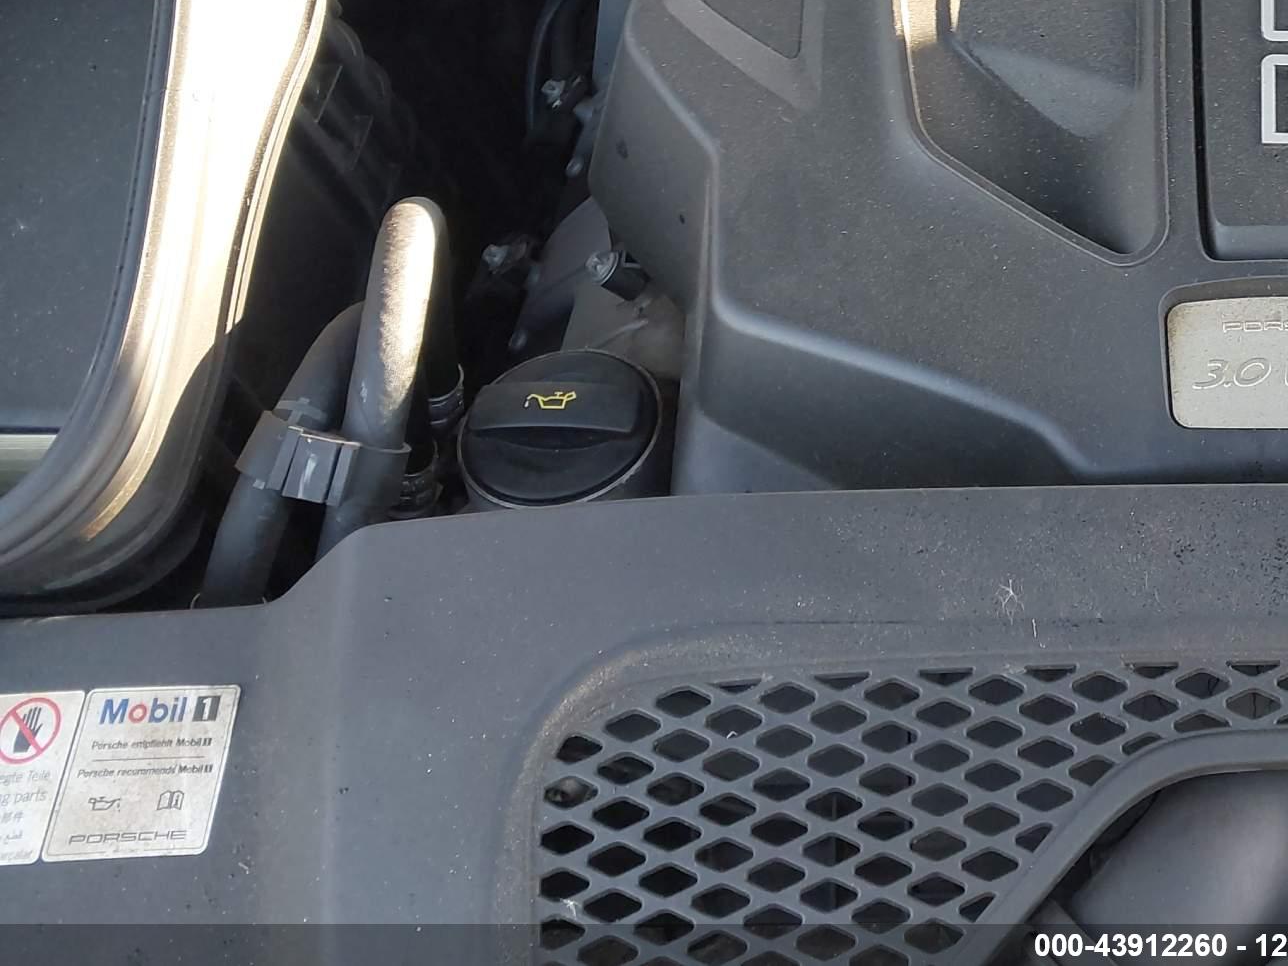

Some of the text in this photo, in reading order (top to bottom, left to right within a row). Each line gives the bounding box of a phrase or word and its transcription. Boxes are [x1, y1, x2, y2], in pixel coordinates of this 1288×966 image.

[1192, 357, 1272, 390] 3.0
[99, 696, 188, 725] Mobil
[91, 741, 129, 751] Porsche
[77, 768, 114, 778] Porsche
[14, 788, 48, 804] parts
[68, 830, 187, 845] PORSCHE
